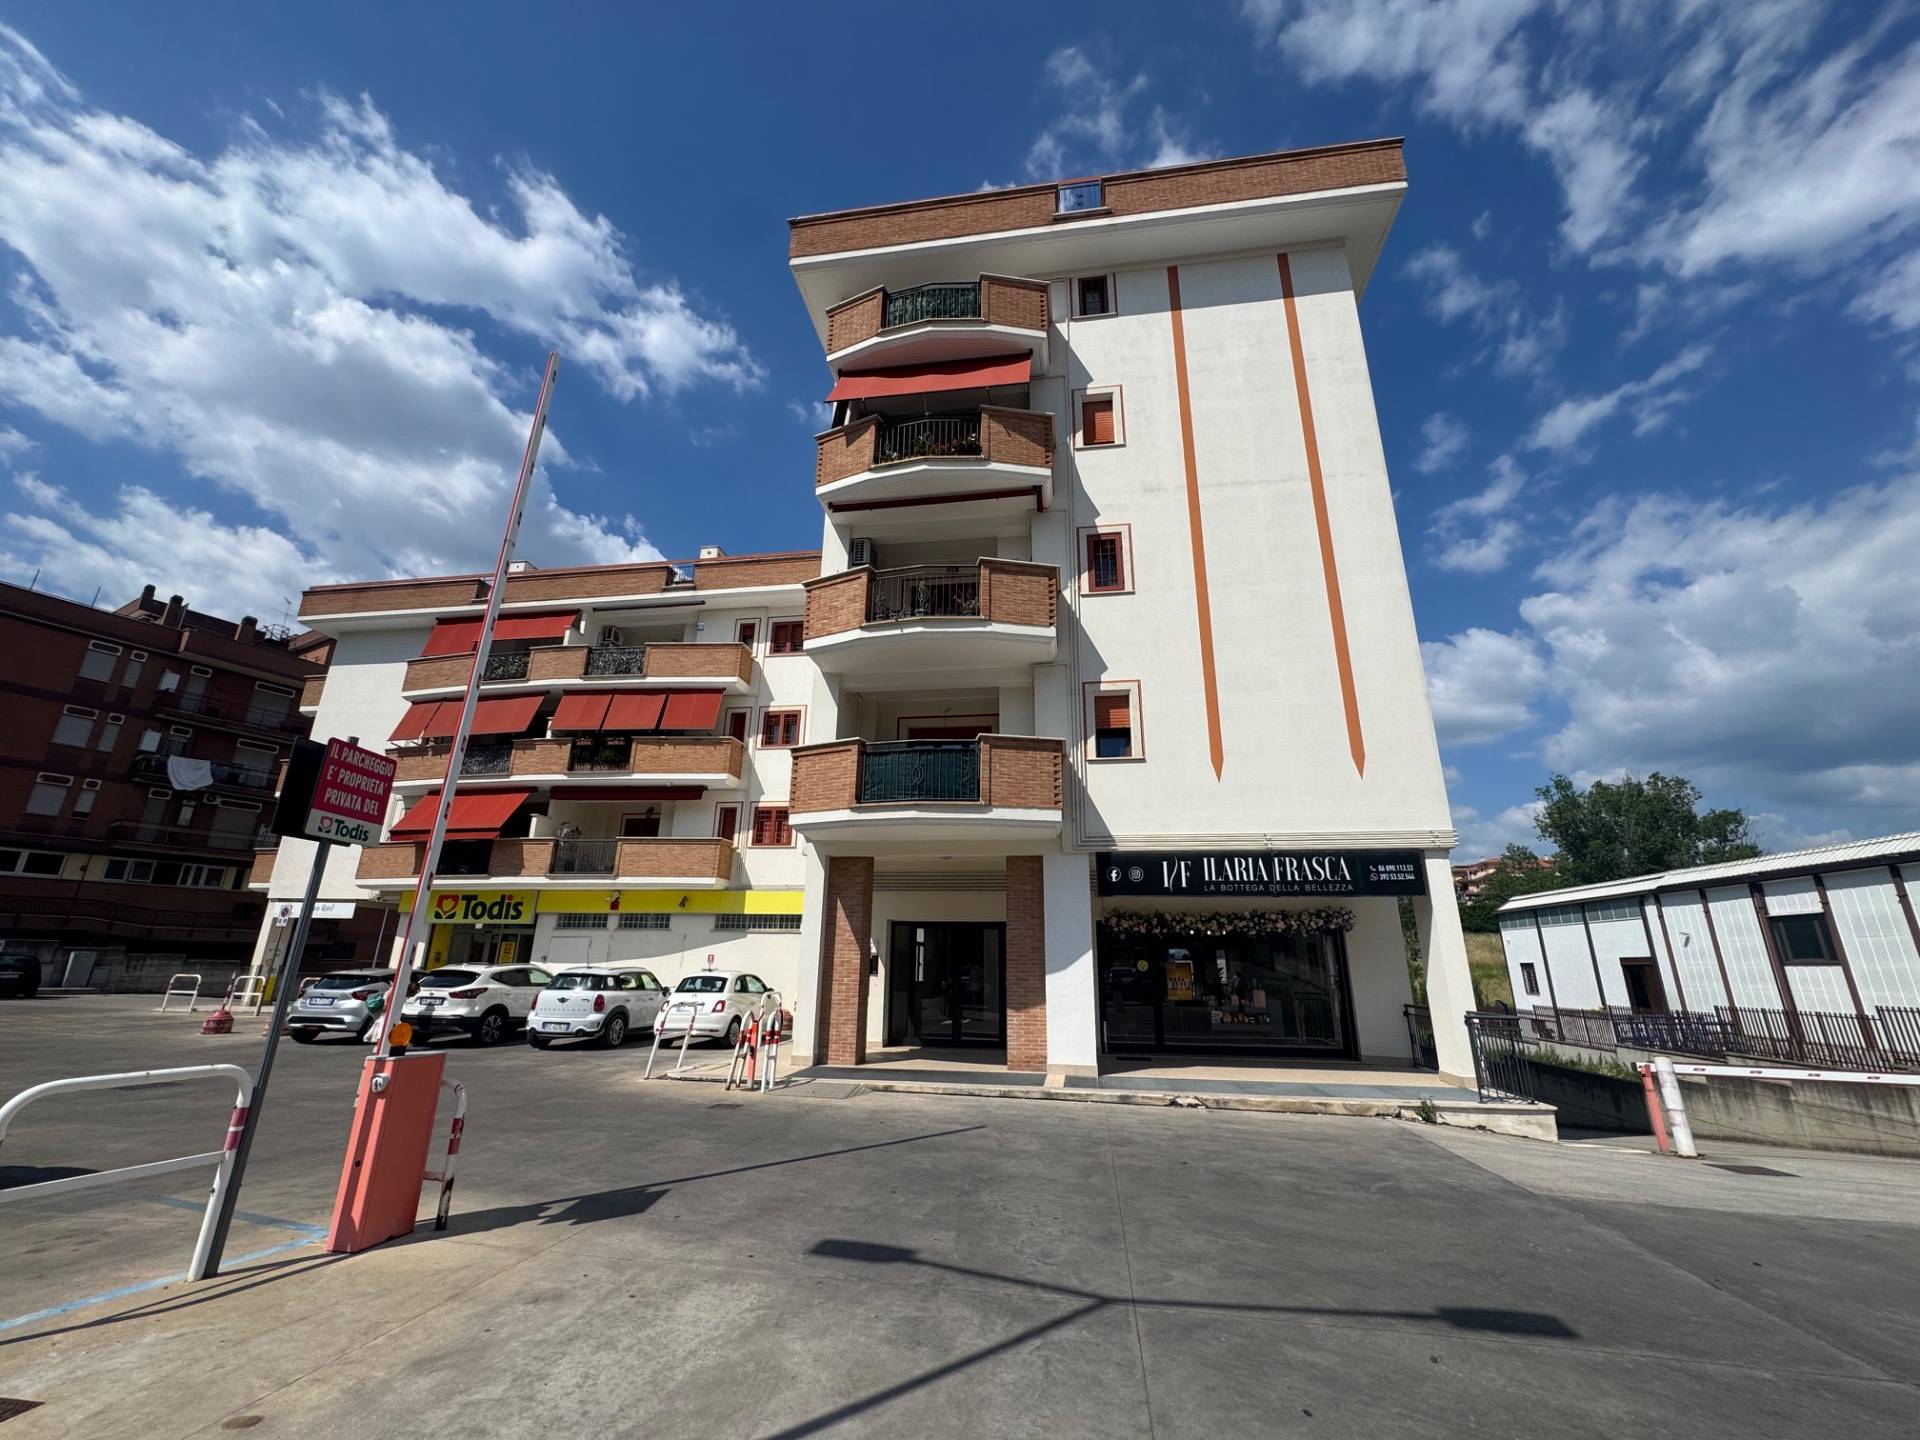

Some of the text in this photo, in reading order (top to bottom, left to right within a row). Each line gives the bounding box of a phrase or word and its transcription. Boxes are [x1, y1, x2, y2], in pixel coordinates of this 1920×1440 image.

[331, 743, 394, 777] IL PARCHEGGIO
[323, 787, 379, 816] PRIVATA DEL
[334, 818, 370, 842] Todis
[1202, 856, 1352, 881] ILARIA FRASCA
[1204, 883, 1354, 892] LA BOTTEGA DELLA BELLEZZA
[461, 893, 524, 920] Todis
